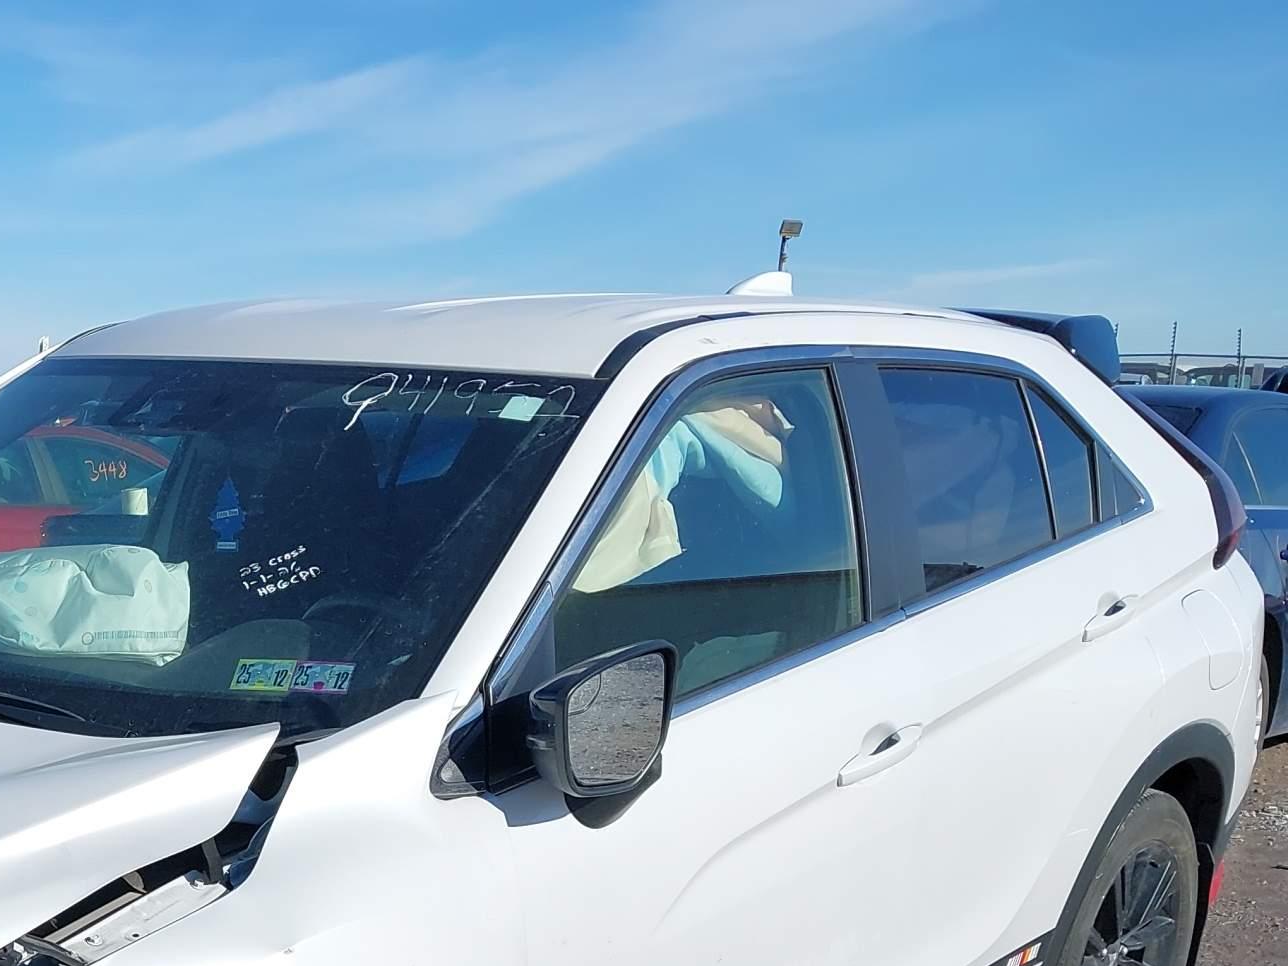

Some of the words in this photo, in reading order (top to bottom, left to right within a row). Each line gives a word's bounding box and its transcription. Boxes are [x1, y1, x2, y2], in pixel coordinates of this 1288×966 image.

[84, 459, 127, 482] 3448
[236, 664, 254, 685] 25
[273, 669, 289, 688] 12
[294, 665, 312, 686] 25
[332, 671, 351, 690] 12
